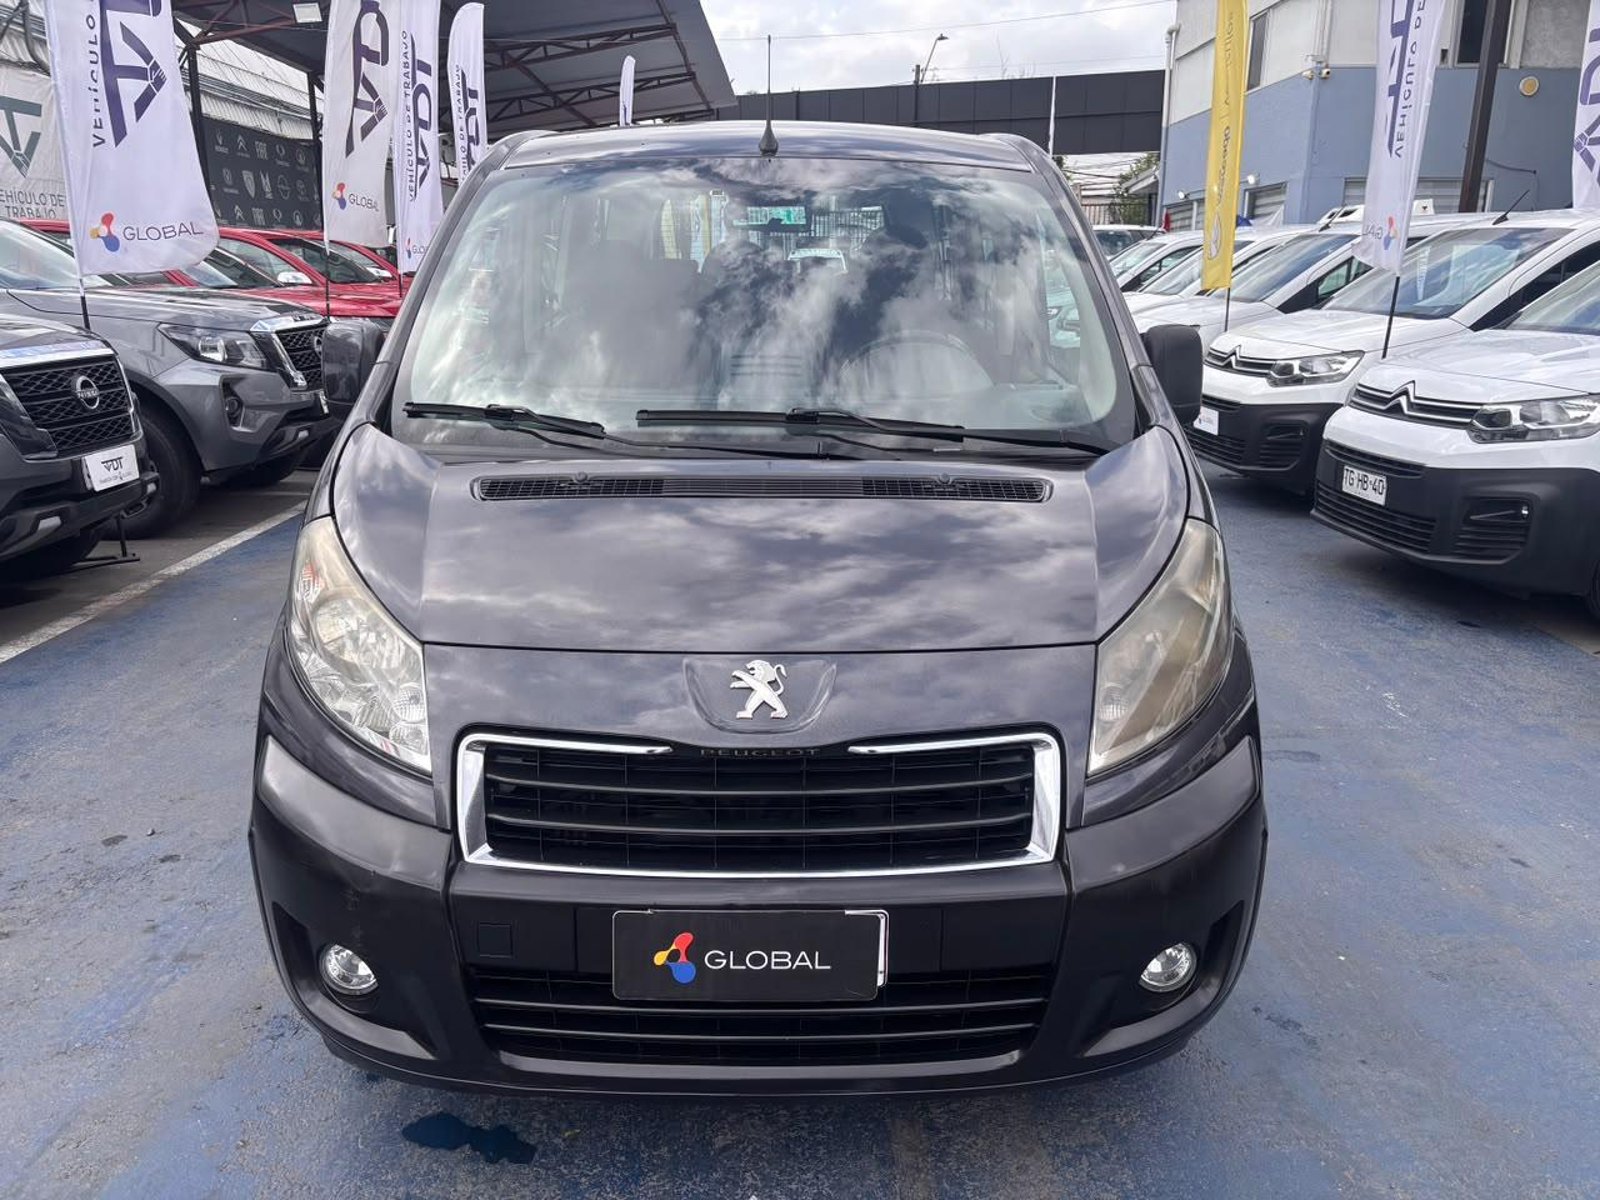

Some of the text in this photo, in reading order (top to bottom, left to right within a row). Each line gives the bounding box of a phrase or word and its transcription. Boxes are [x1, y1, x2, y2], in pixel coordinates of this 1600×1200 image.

[401, 30, 411, 98] TRABAJO
[49, 193, 65, 207] DE
[123, 222, 204, 242] GLOBAL
[704, 949, 832, 970] GLOBAL
